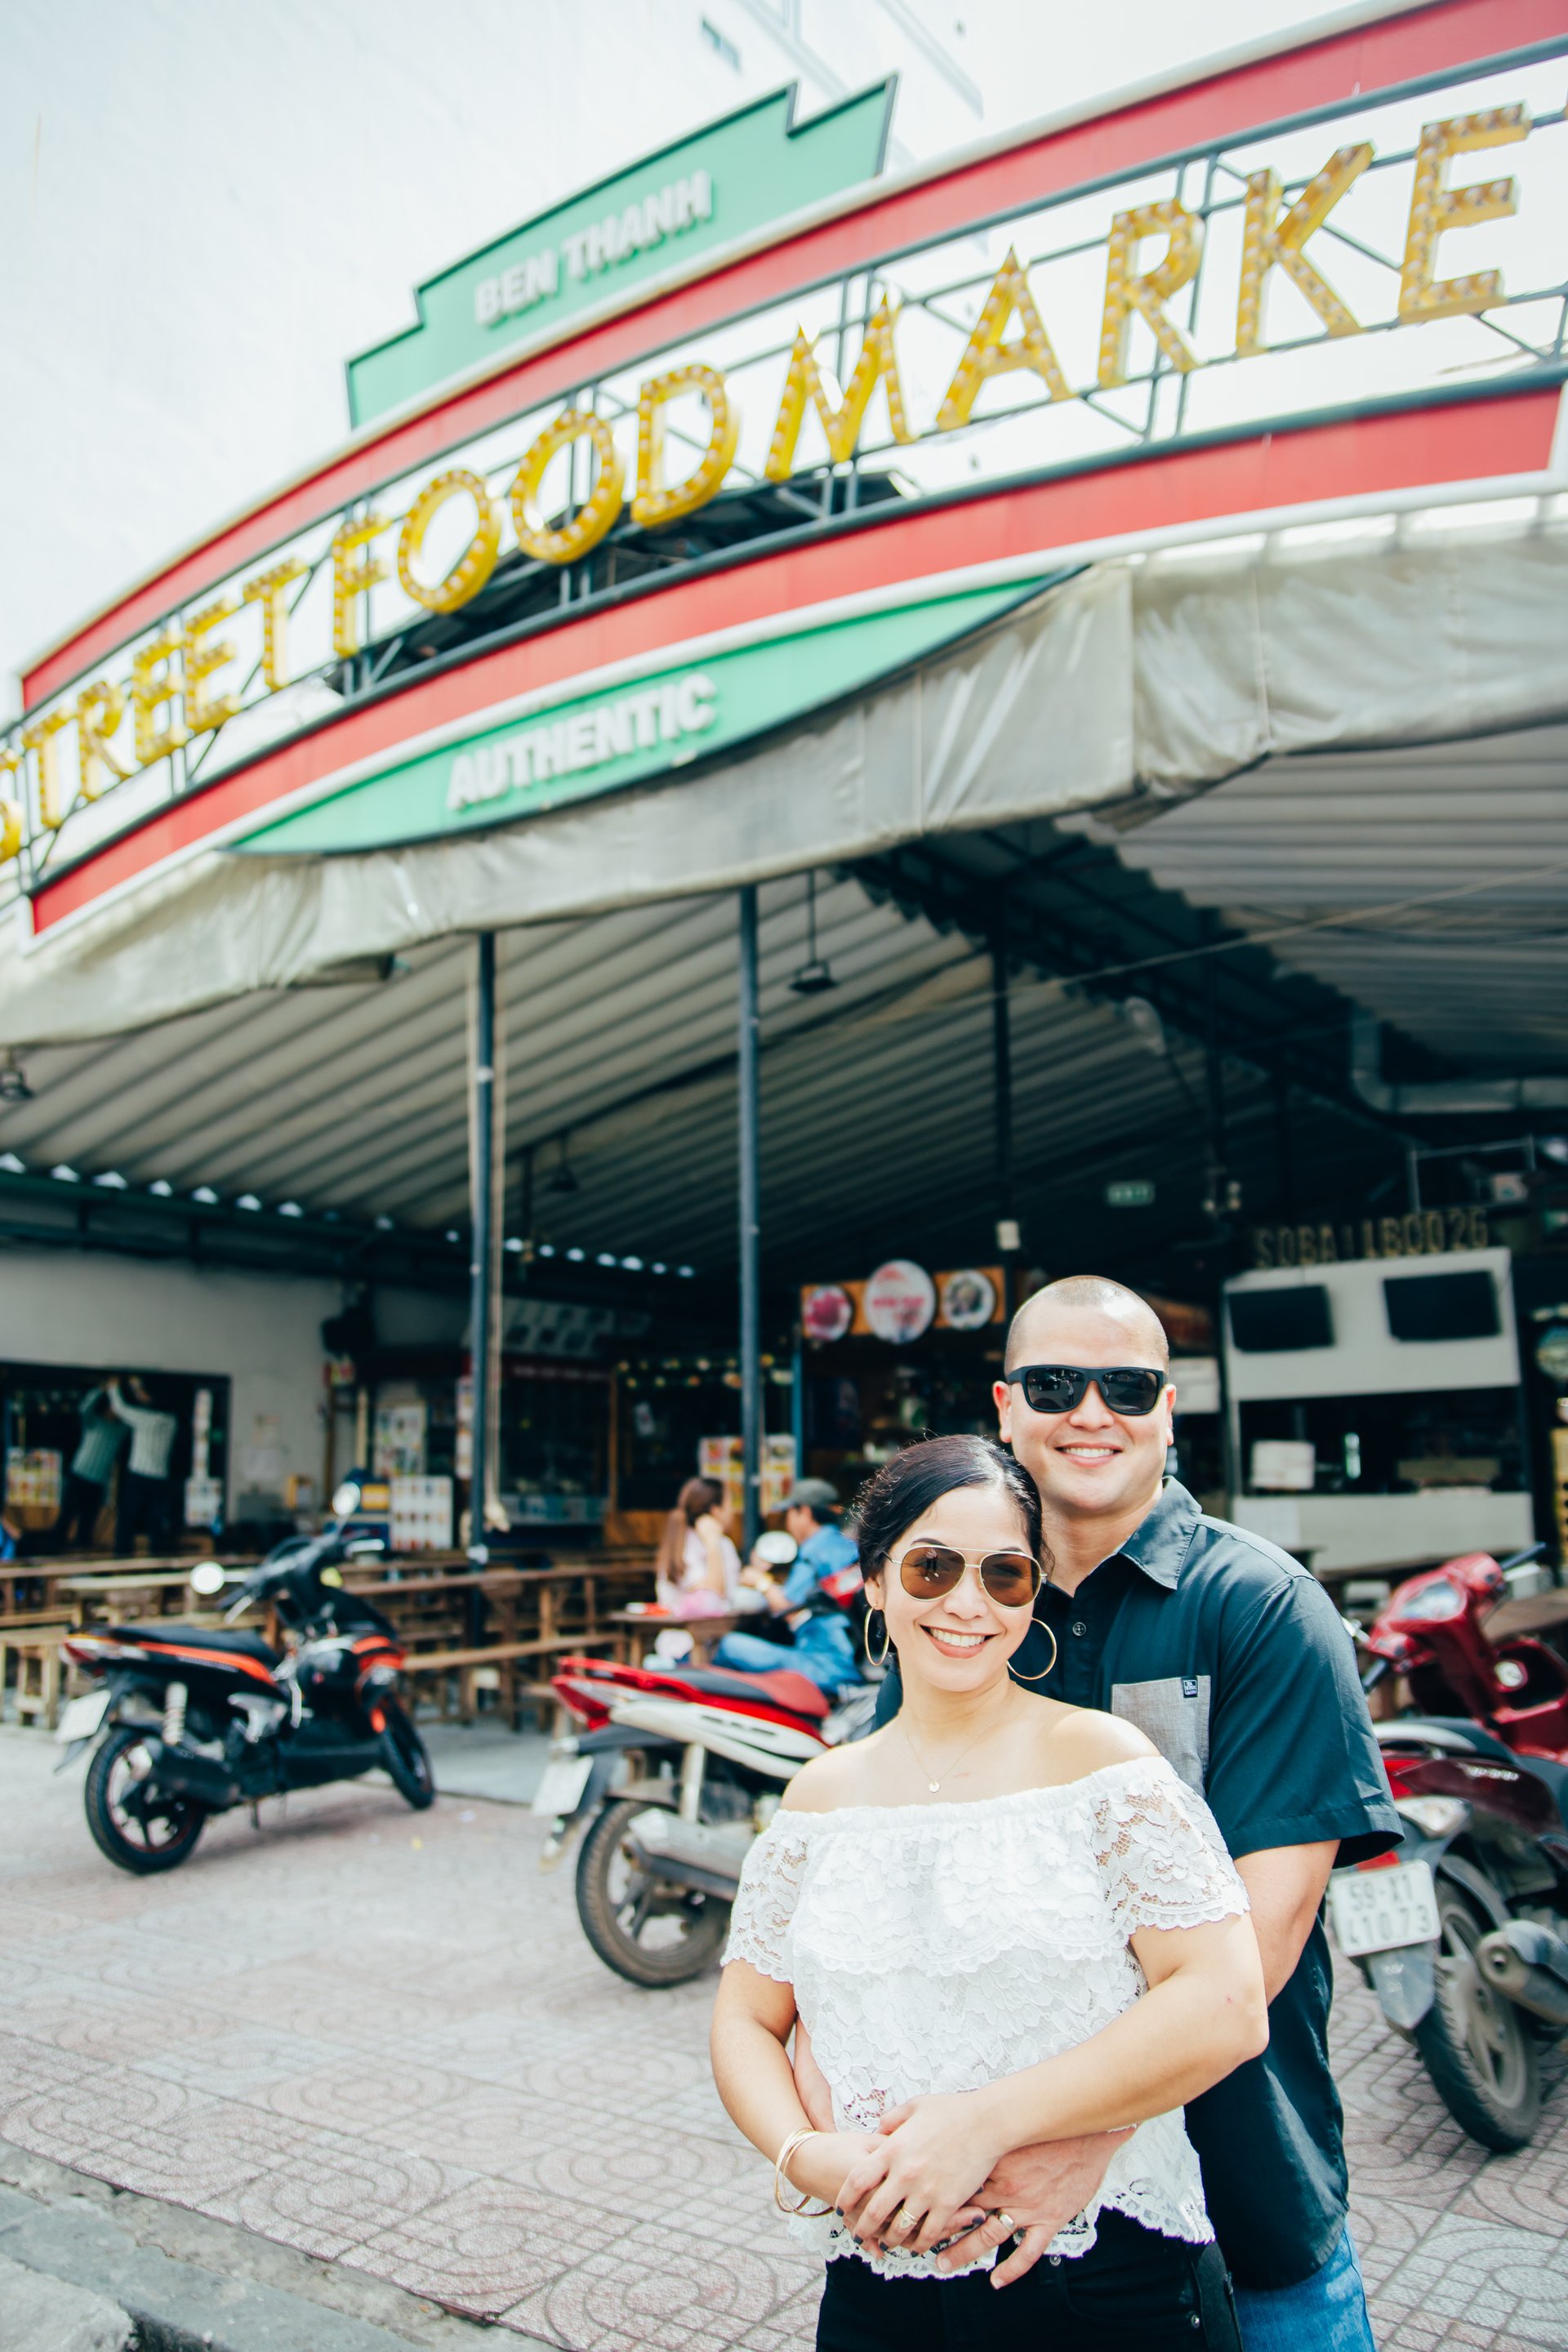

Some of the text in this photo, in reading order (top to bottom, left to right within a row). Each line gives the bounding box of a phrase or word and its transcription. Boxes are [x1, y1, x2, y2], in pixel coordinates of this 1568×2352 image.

[474, 169, 713, 324] BEN THANH
[332, 362, 742, 658] FOOD
[764, 100, 1568, 482] MARKE
[447, 673, 717, 810] AUTHENTIC
[1348, 1872, 1414, 1912] 59-X1
